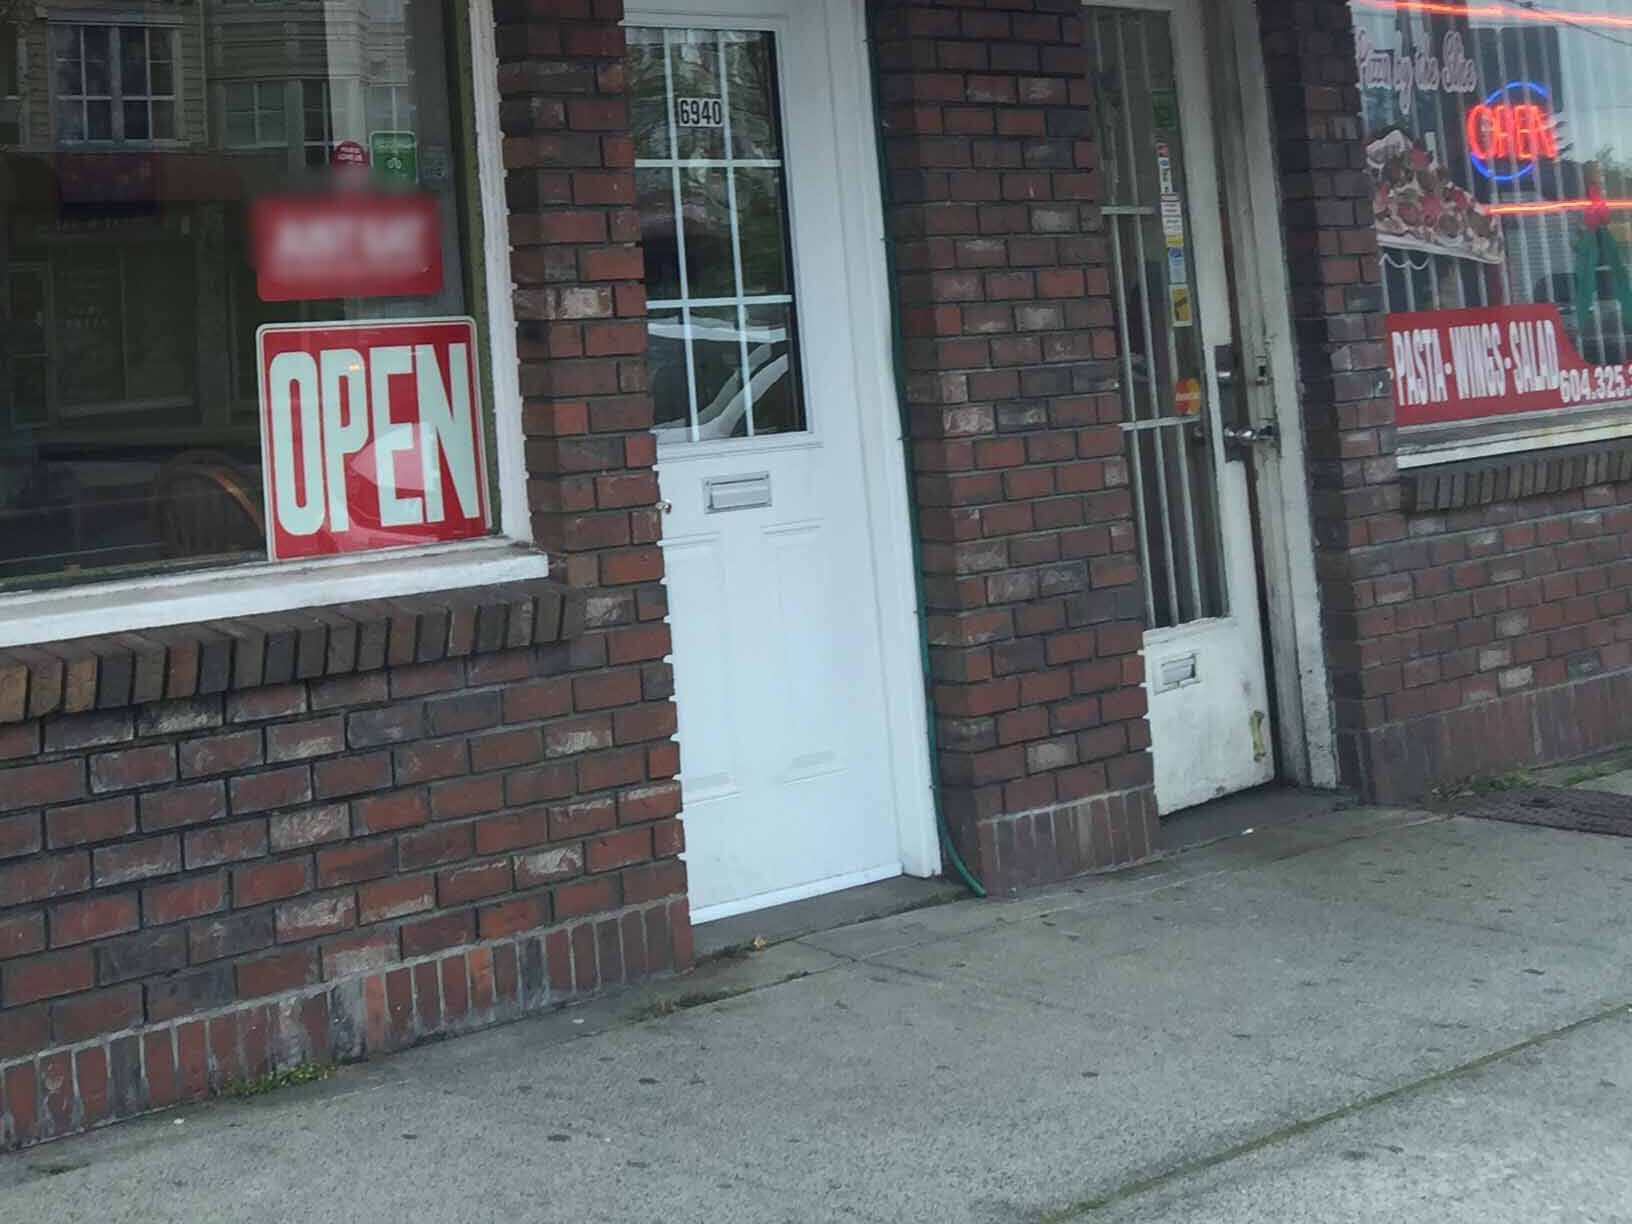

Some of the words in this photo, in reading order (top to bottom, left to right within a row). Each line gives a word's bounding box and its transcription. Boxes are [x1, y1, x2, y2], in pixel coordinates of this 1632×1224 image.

[679, 99, 722, 125] 6940
[1466, 103, 1557, 161] OPEN
[1392, 328, 1448, 406] PASTA
[269, 343, 480, 537] OPEN
